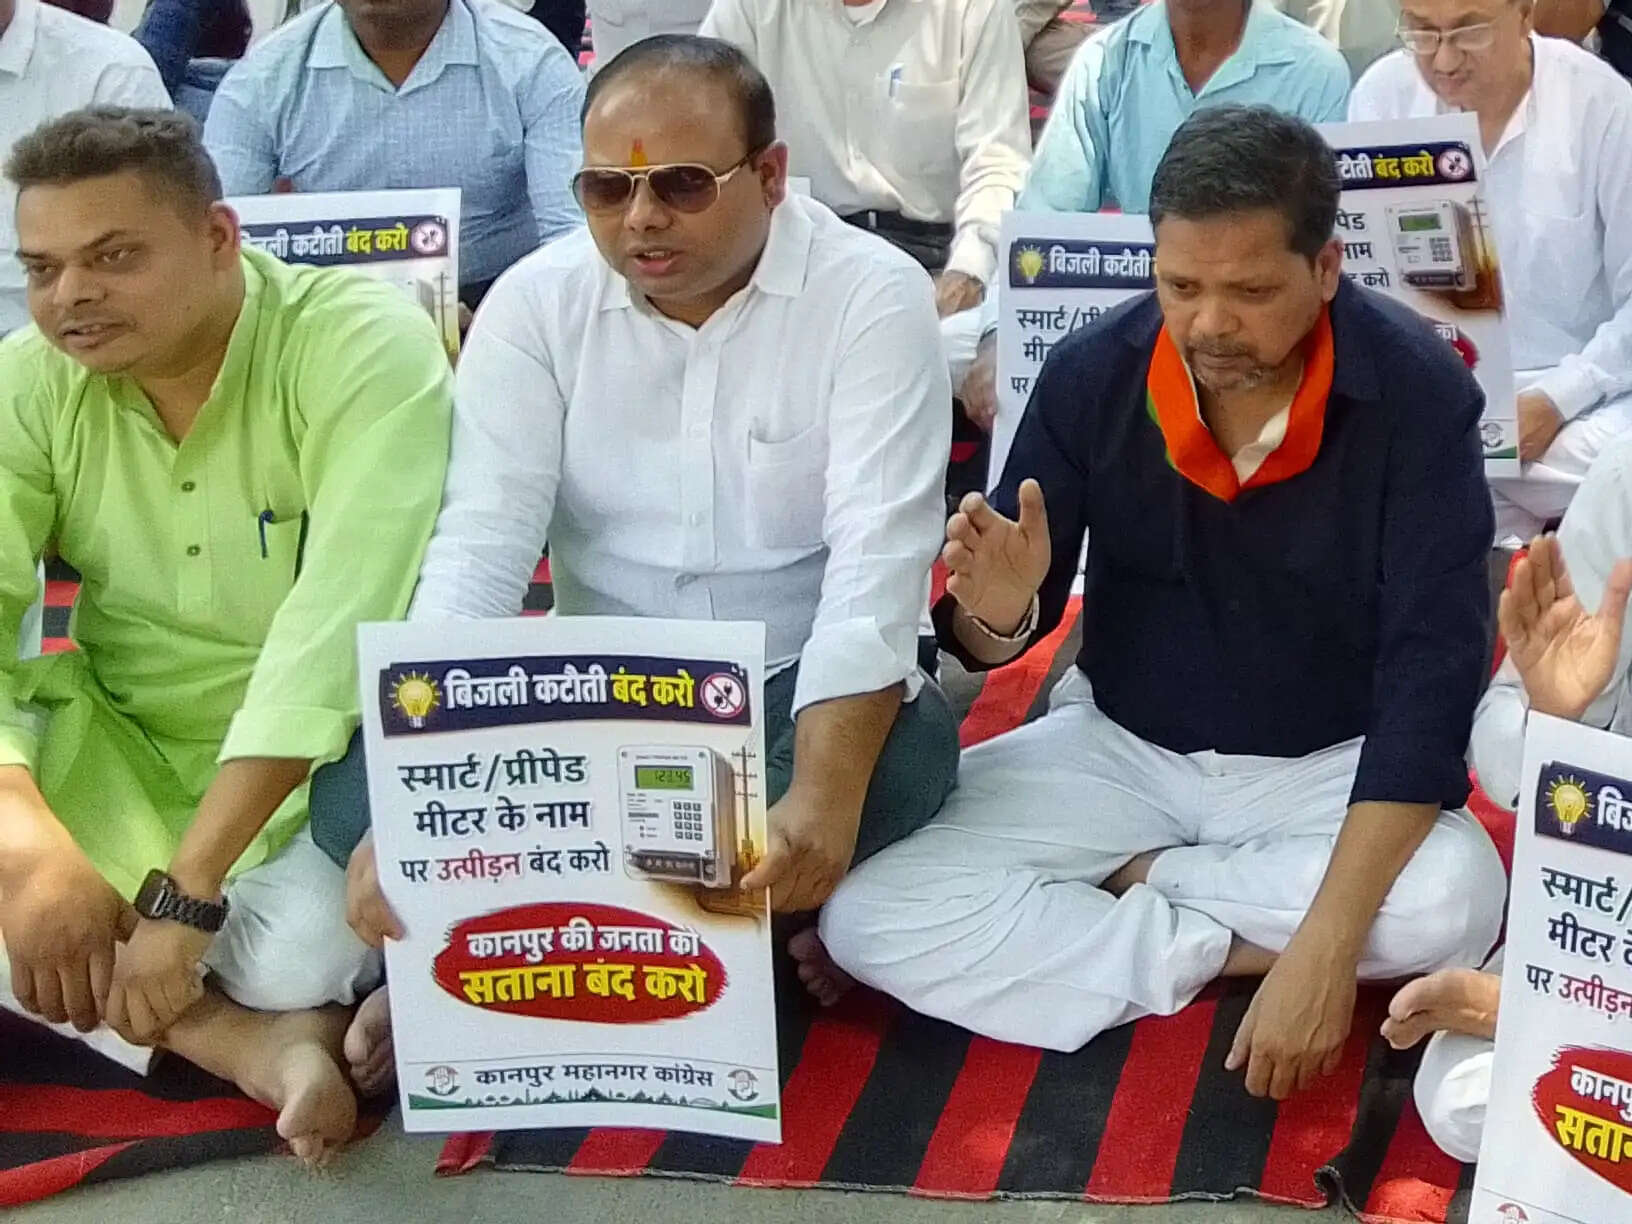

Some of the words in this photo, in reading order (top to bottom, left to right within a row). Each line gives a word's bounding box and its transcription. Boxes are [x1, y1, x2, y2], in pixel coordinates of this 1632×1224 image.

[1373, 154, 1401, 179] बंद
[1400, 150, 1434, 178] करो
[291, 225, 344, 256] कटौती
[346, 226, 372, 254] बंद
[375, 222, 409, 251] करो
[1050, 245, 1100, 275] बिजली
[1103, 248, 1150, 278] कटौती
[1362, 267, 1390, 288] करो
[1011, 376, 1029, 394] पर
[443, 665, 528, 709] बिजली
[533, 663, 608, 706] कटौती
[611, 669, 649, 706] बंद
[652, 668, 694, 708] करो
[398, 748, 586, 792] स्मार्ट/प्रीपेड
[415, 797, 486, 837] मीटर
[496, 796, 526, 832] के
[535, 801, 590, 829] नाम
[401, 859, 428, 882] पर
[436, 850, 521, 885] उत्पीड़न
[529, 846, 564, 874] बंद
[569, 841, 610, 872] करो
[468, 926, 554, 963] कानपुर
[560, 916, 598, 954] की
[599, 929, 664, 956] जनता
[668, 924, 702, 958] को
[1548, 913, 1615, 964] मीटर
[460, 964, 575, 1005] सताना
[584, 957, 634, 1000] बंद
[642, 963, 707, 1004] करो
[1526, 965, 1550, 994] पर
[475, 1065, 554, 1089] कानपुर
[562, 1064, 648, 1082] महानगर
[655, 1064, 713, 1088] कांग्रेस
